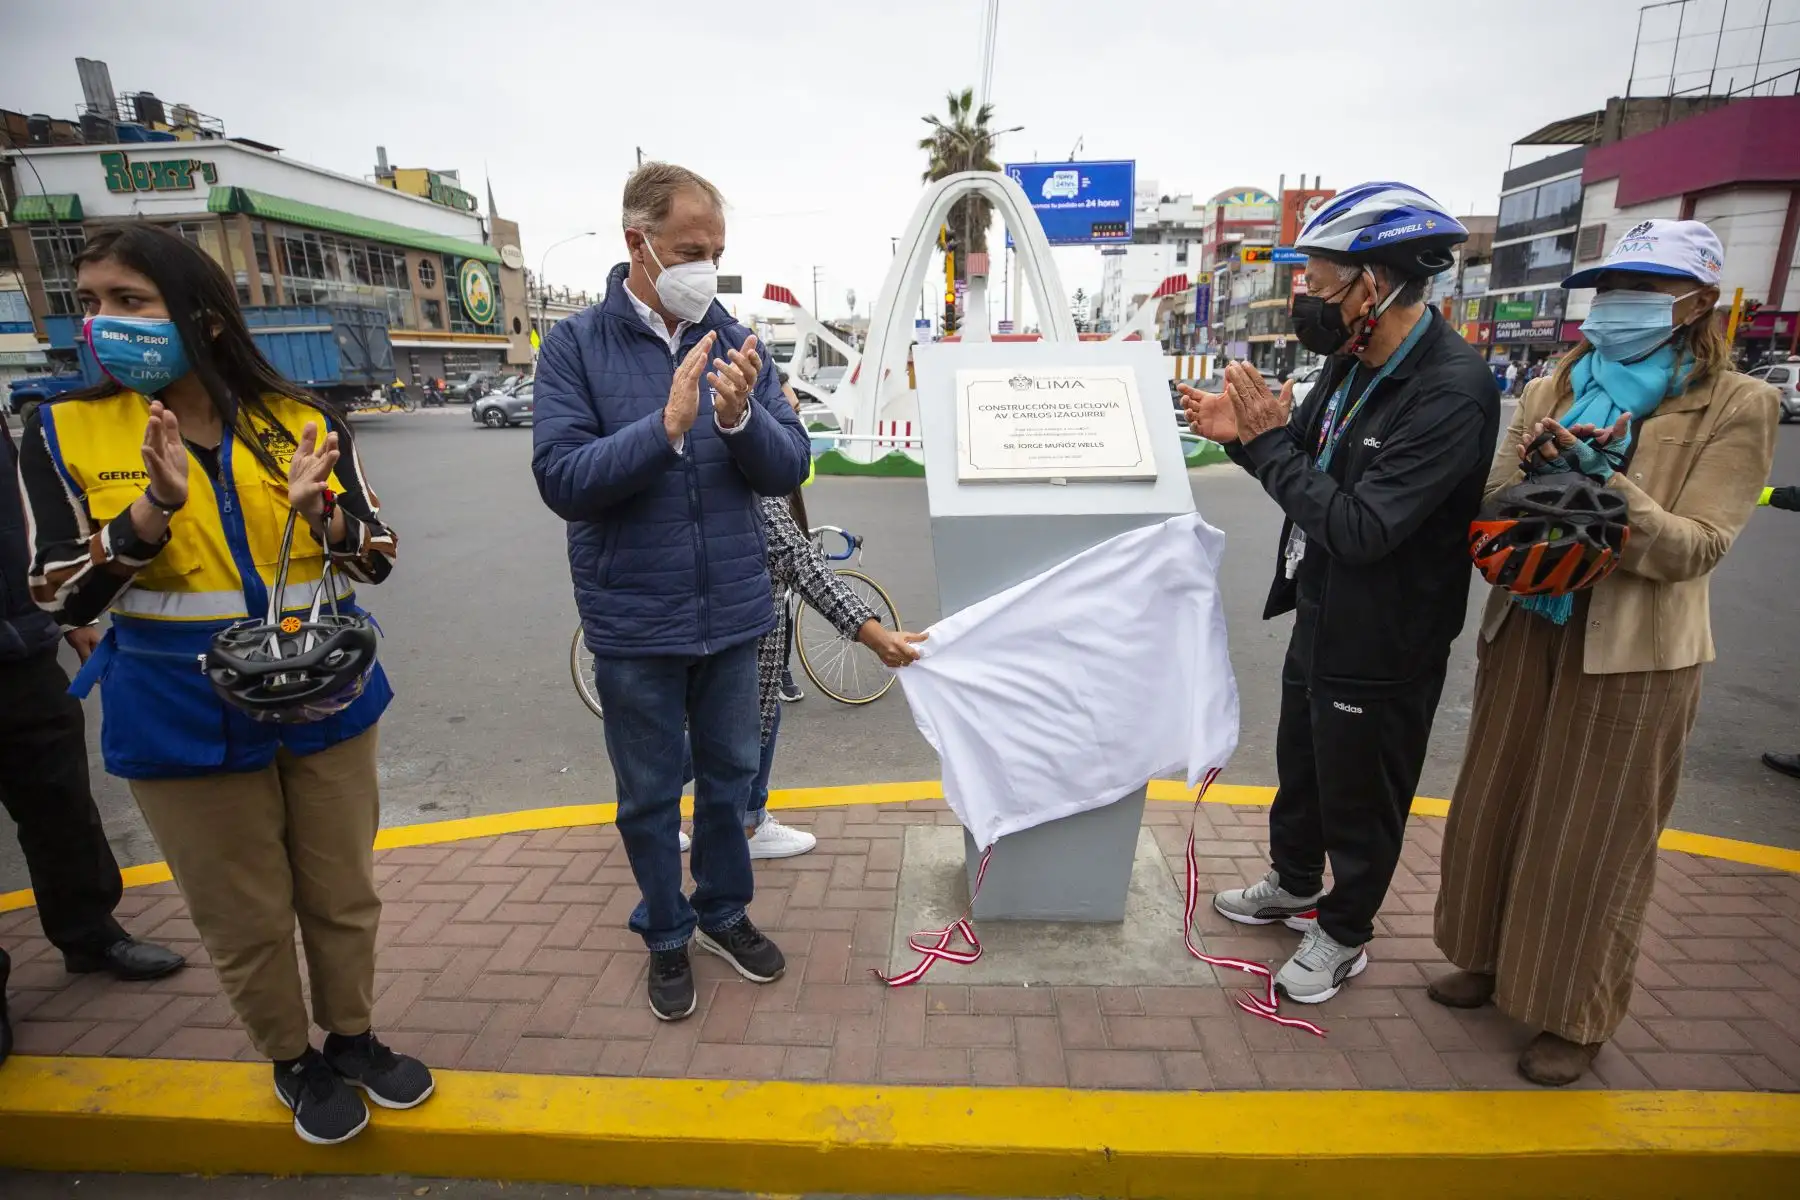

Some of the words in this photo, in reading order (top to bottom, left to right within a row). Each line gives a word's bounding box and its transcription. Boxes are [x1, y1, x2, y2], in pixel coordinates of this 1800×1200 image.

[1085, 199, 1096, 208] 24
[1377, 223, 1423, 241] PROWELL
[101, 330, 133, 343] BIEN,
[1496, 330, 1511, 339] SAN
[1511, 327, 1554, 338] BARTOLOME
[131, 370, 171, 380] LIMA
[1036, 380, 1086, 390] LIMA
[978, 402, 1057, 411] CONSTRUCCIÓN
[98, 471, 151, 481] GEREN
[1333, 701, 1363, 714] adidas
